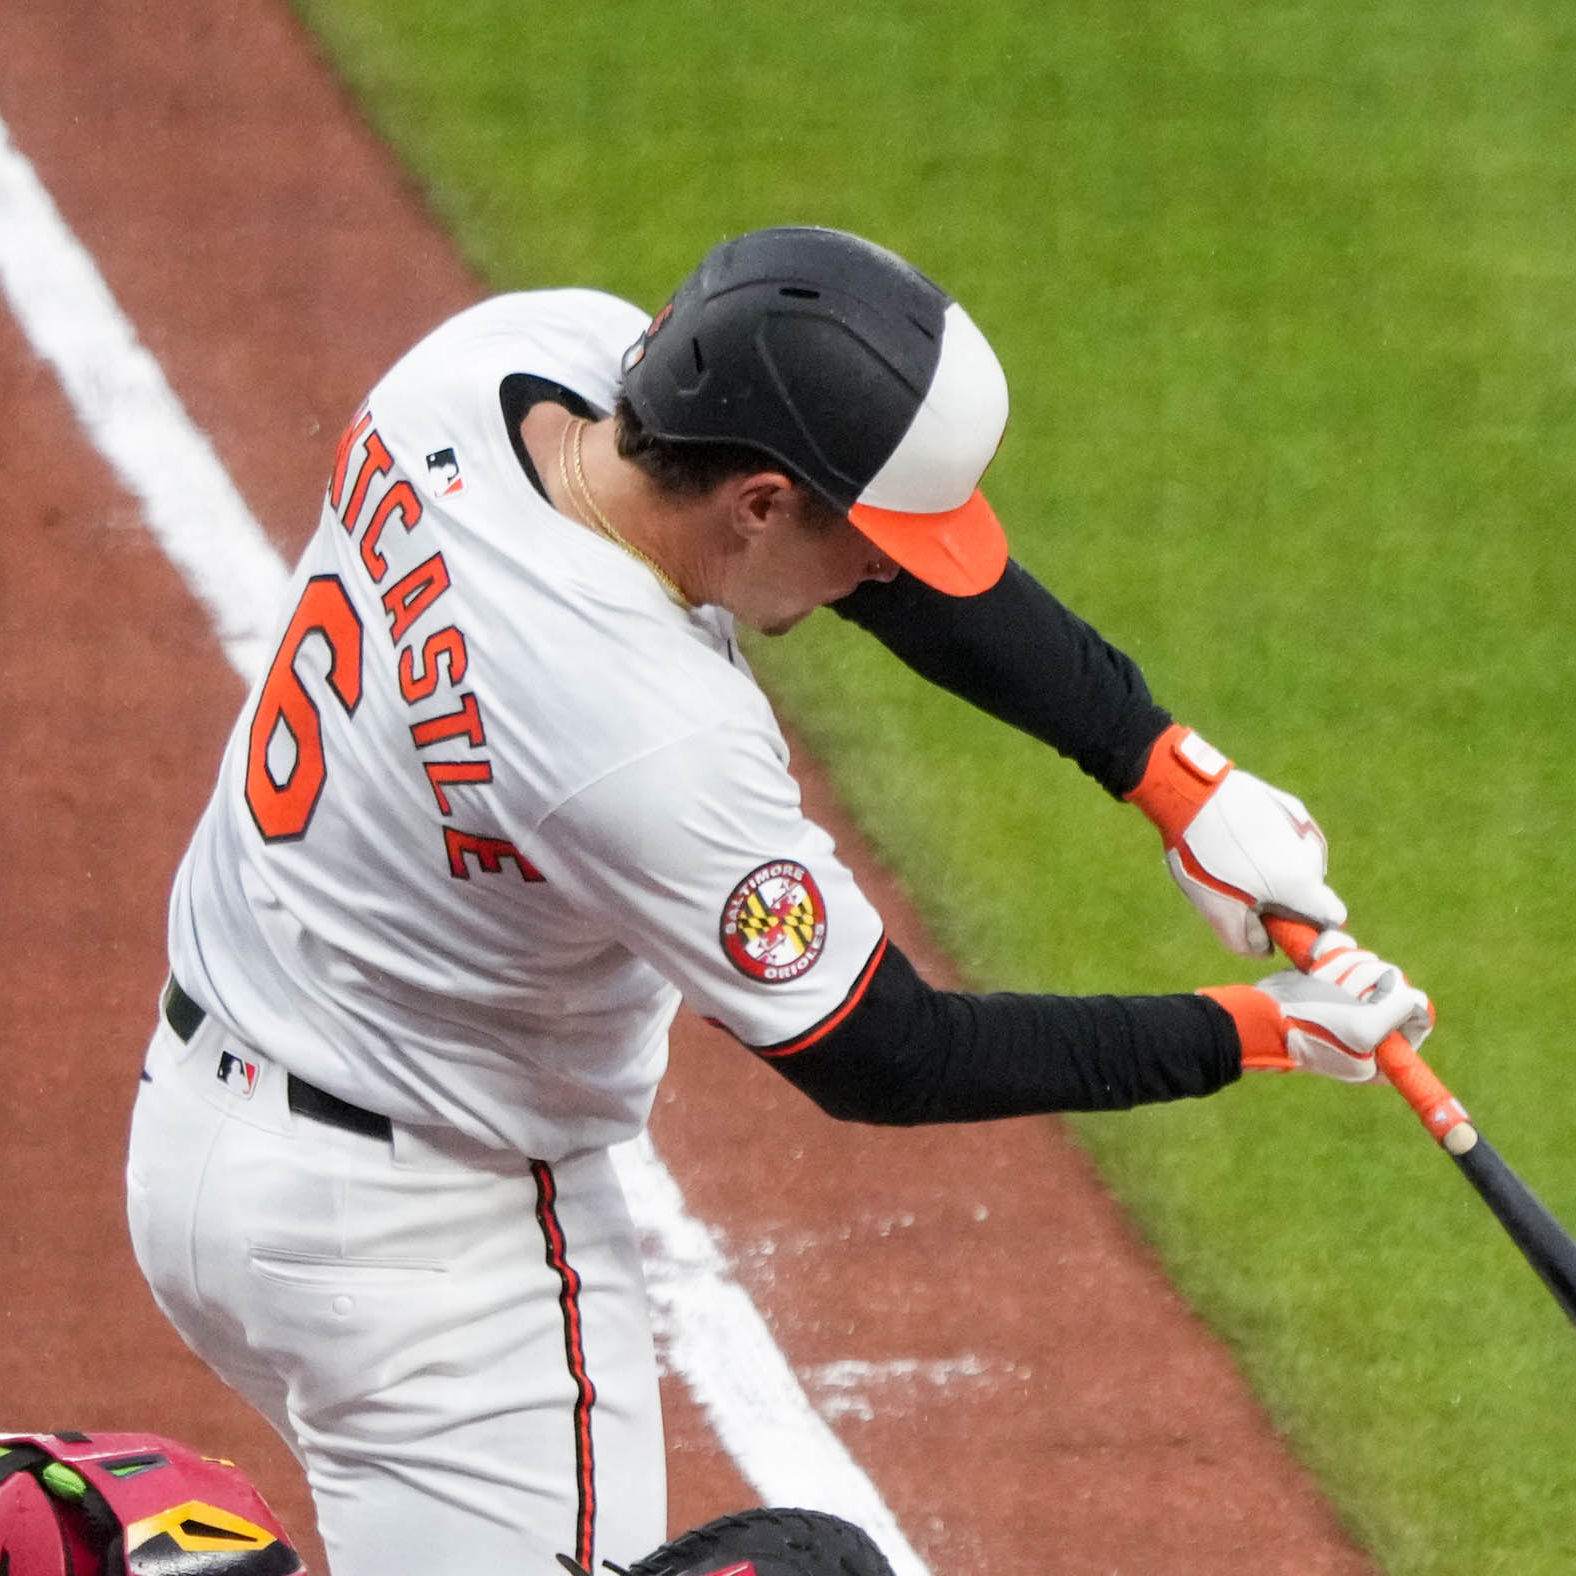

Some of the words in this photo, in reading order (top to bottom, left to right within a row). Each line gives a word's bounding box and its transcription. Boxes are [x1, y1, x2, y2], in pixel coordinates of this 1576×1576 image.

[244, 574, 364, 845] 6
[725, 863, 805, 934] BALTIMORE
[764, 923, 825, 979] ORIOLES
